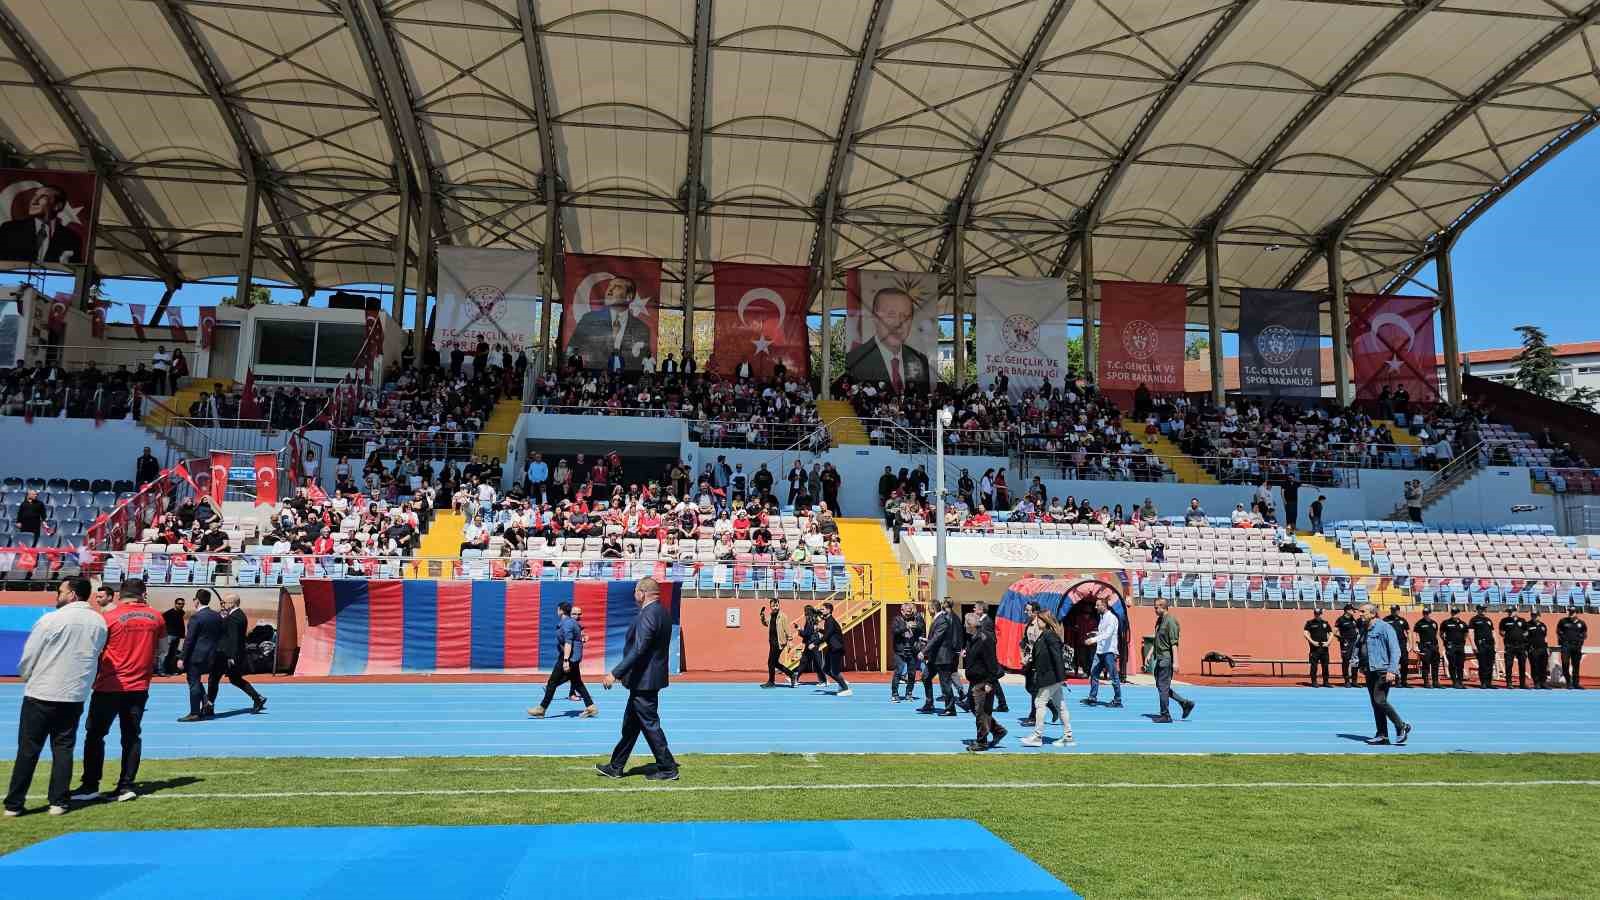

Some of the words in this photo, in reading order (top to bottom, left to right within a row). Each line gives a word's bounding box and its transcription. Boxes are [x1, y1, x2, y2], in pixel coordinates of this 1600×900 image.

[1047, 359, 1060, 367] VE
[1107, 361, 1123, 370] T.C.
[1164, 364, 1177, 374] VE
[1106, 371, 1131, 381] SPOR
[1244, 367, 1260, 375] T.C.
[1261, 366, 1298, 377] GENÇLİK
[1301, 367, 1313, 376] VE
[1246, 376, 1269, 384] SPOR
[1270, 377, 1313, 386] BAKANLIĞI
